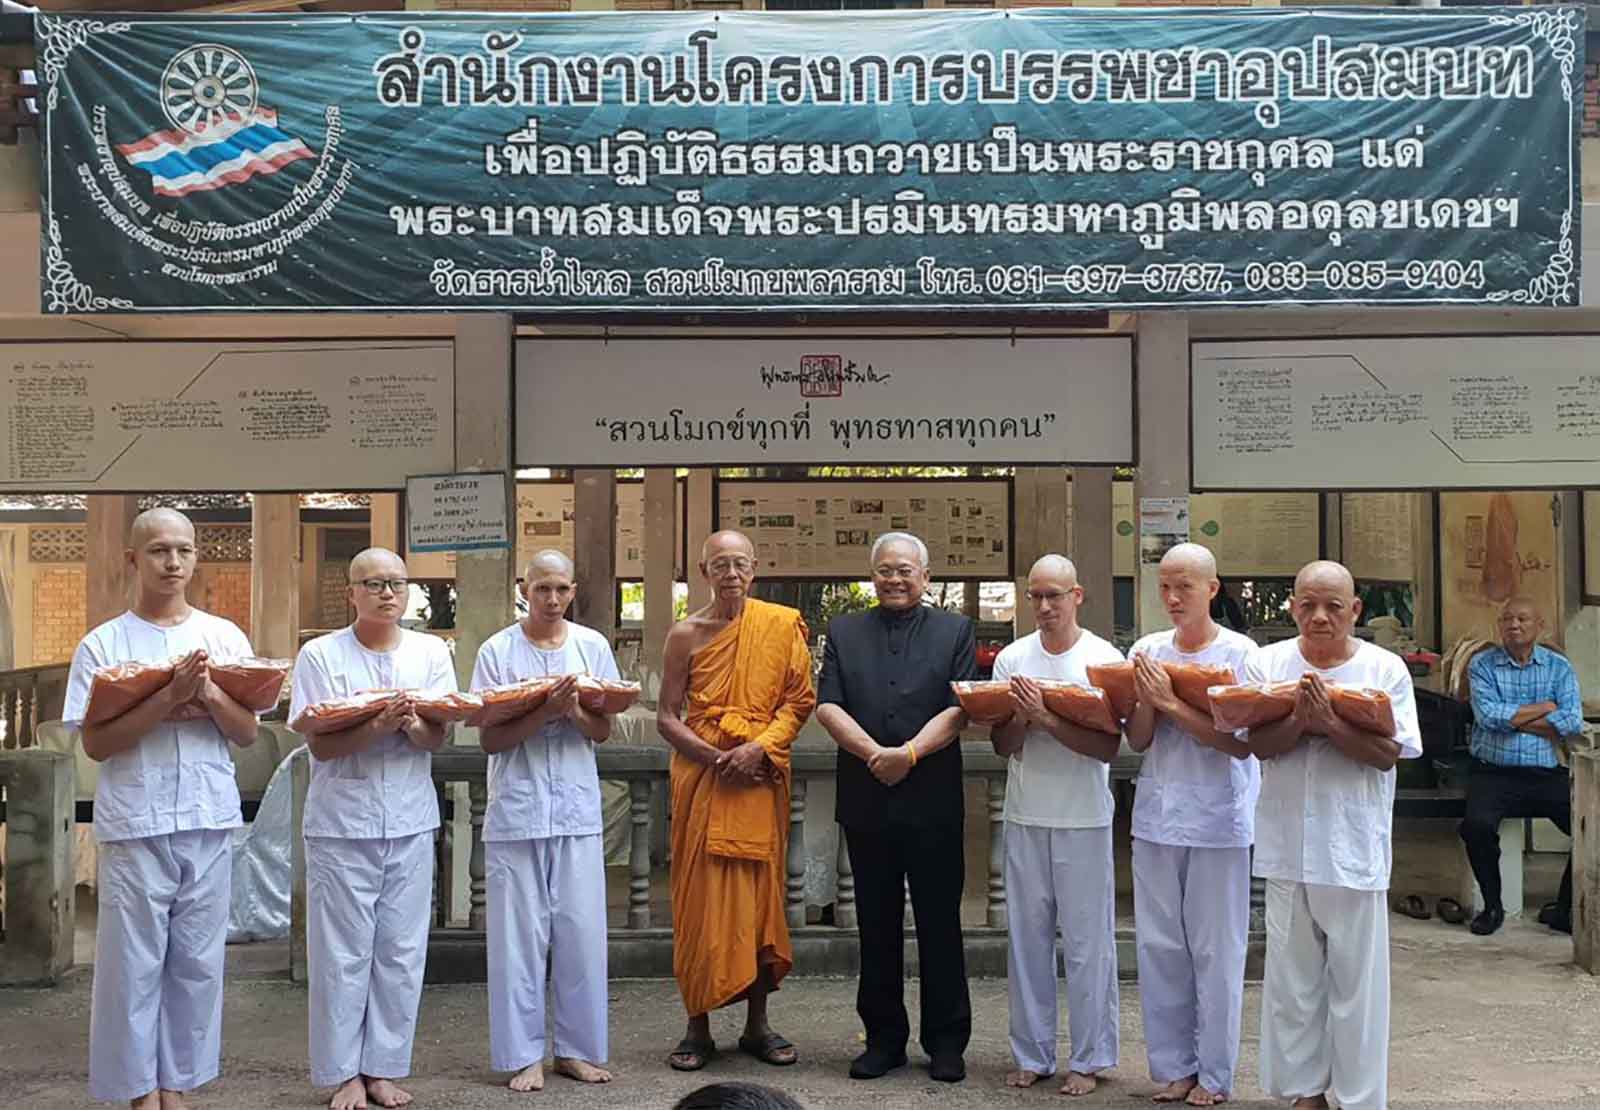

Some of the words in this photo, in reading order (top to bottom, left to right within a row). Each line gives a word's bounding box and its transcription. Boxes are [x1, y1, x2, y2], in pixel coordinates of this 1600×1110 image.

[374, 28, 1534, 128] สำนักงานโครงการบรรพชาอุปสมบท
[485, 117, 1334, 187] เพื่อปฏิบัติธรรมถวายเป็นพระราชกุศล
[1361, 124, 1425, 169] แด่
[389, 187, 1519, 250] พระบาทสมเด็จพระปรมินทรมหาภูมิพลอดุลยเดชฯ
[430, 246, 632, 297] วัดธารน้ำไหล
[644, 258, 906, 297] สวนโมกขพลาราม
[1244, 260, 1486, 291] 083-085-9404
[594, 402, 812, 448] “สวนโมกข์ทุกที่
[829, 411, 1057, 449] พุทธทาสทุกคน”
